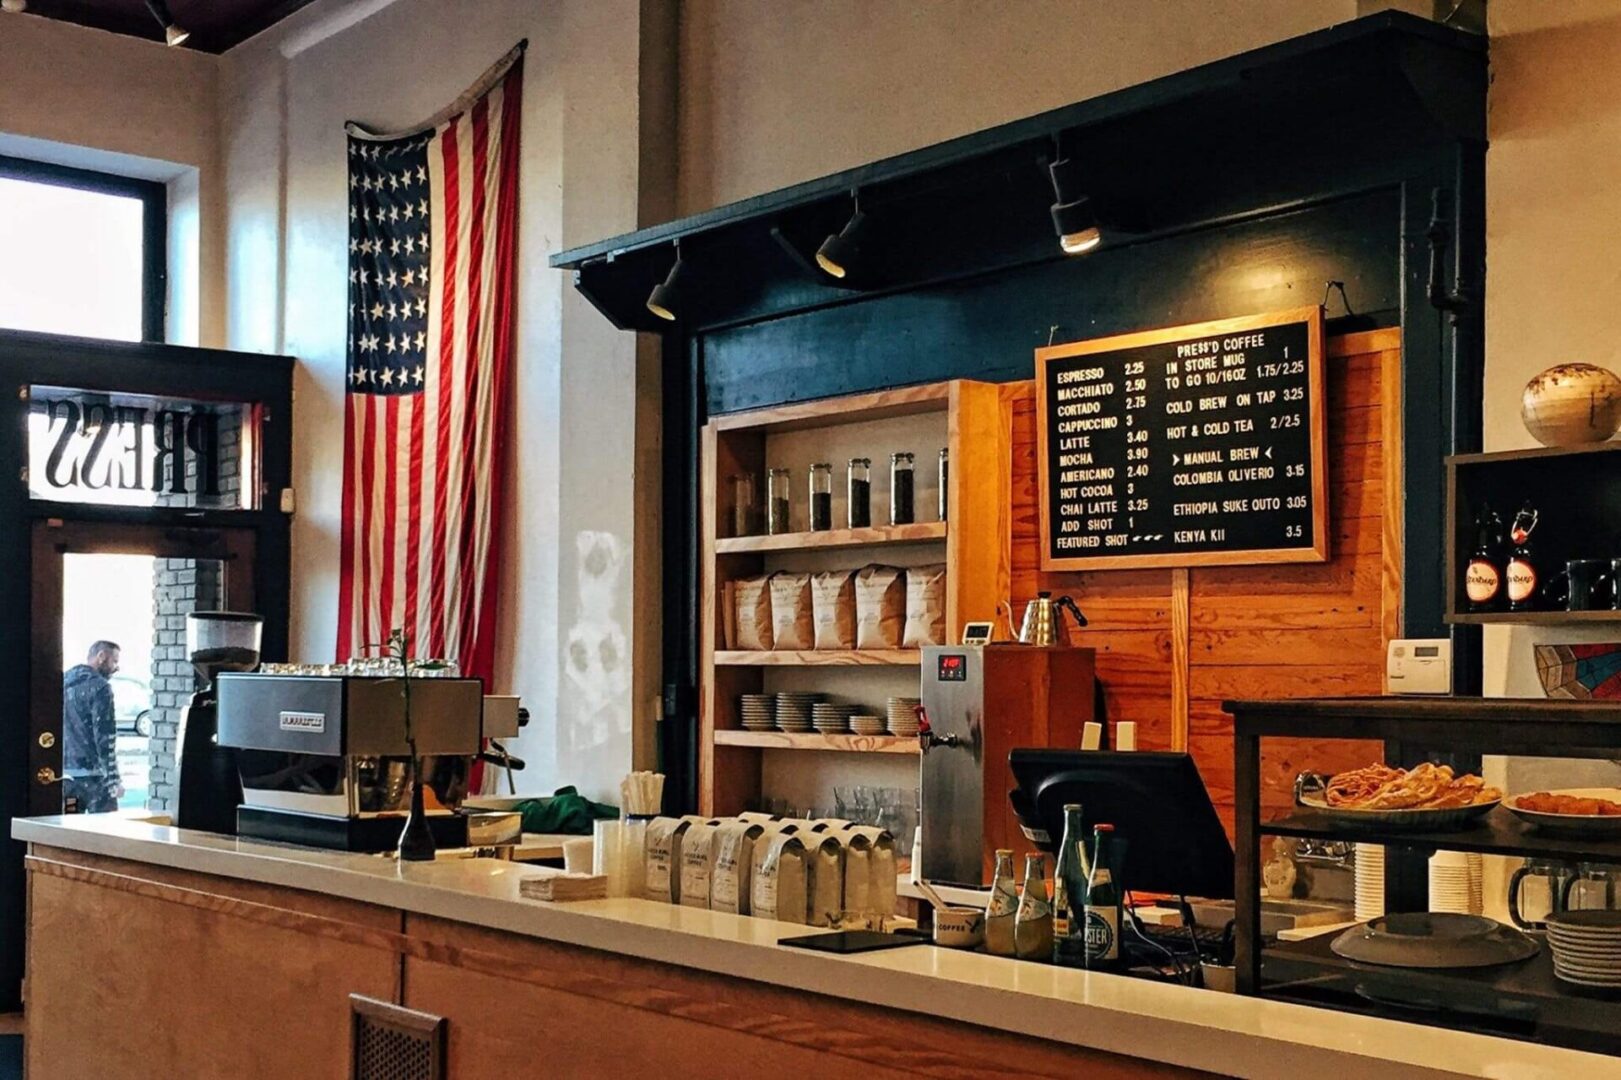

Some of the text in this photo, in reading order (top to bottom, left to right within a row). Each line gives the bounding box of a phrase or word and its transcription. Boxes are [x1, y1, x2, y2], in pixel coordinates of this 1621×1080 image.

[1224, 334, 1265, 350] COFFEE
[1166, 347, 1288, 374] IN STORE MUG 1
[1057, 362, 1144, 384] ESPRESSO 2.25
[1165, 377, 1179, 389] TO
[1186, 374, 1201, 386] GO
[1057, 379, 1146, 401] MACCHIATO 2.50
[1057, 396, 1146, 416] CORTADO 2.75
[1166, 400, 1193, 414] COLD
[1200, 396, 1227, 410] BREW
[1237, 394, 1250, 406] ON
[1257, 391, 1276, 404] TAP
[1058, 415, 1133, 433] CAPPUCCINO 3
[1167, 426, 1187, 439] HOT
[1191, 425, 1199, 437] &
[1204, 422, 1230, 436] COLD
[1234, 419, 1254, 432] TEA
[1060, 430, 1148, 450] LATTE 3.40
[1060, 448, 1148, 466] MOCHA 3.90
[1184, 447, 1259, 465] MANUAL BREW
[1061, 464, 1148, 483] AMERICANO 2.40
[1173, 464, 1304, 486] COLOMBIA OLIVERIO 3.15
[1061, 483, 1134, 499] HOT COCOA 3
[1061, 499, 1148, 515] CHAI LATTE 3.25
[1173, 500, 1218, 516] ETHIOPIA
[1223, 499, 1249, 513] SUKE
[1287, 496, 1307, 509] 3.05
[1061, 517, 1134, 532] ADD SHOT 1
[1057, 534, 1128, 549] FEATURED SHOT
[1174, 525, 1302, 543] KENYA KII 3.5
